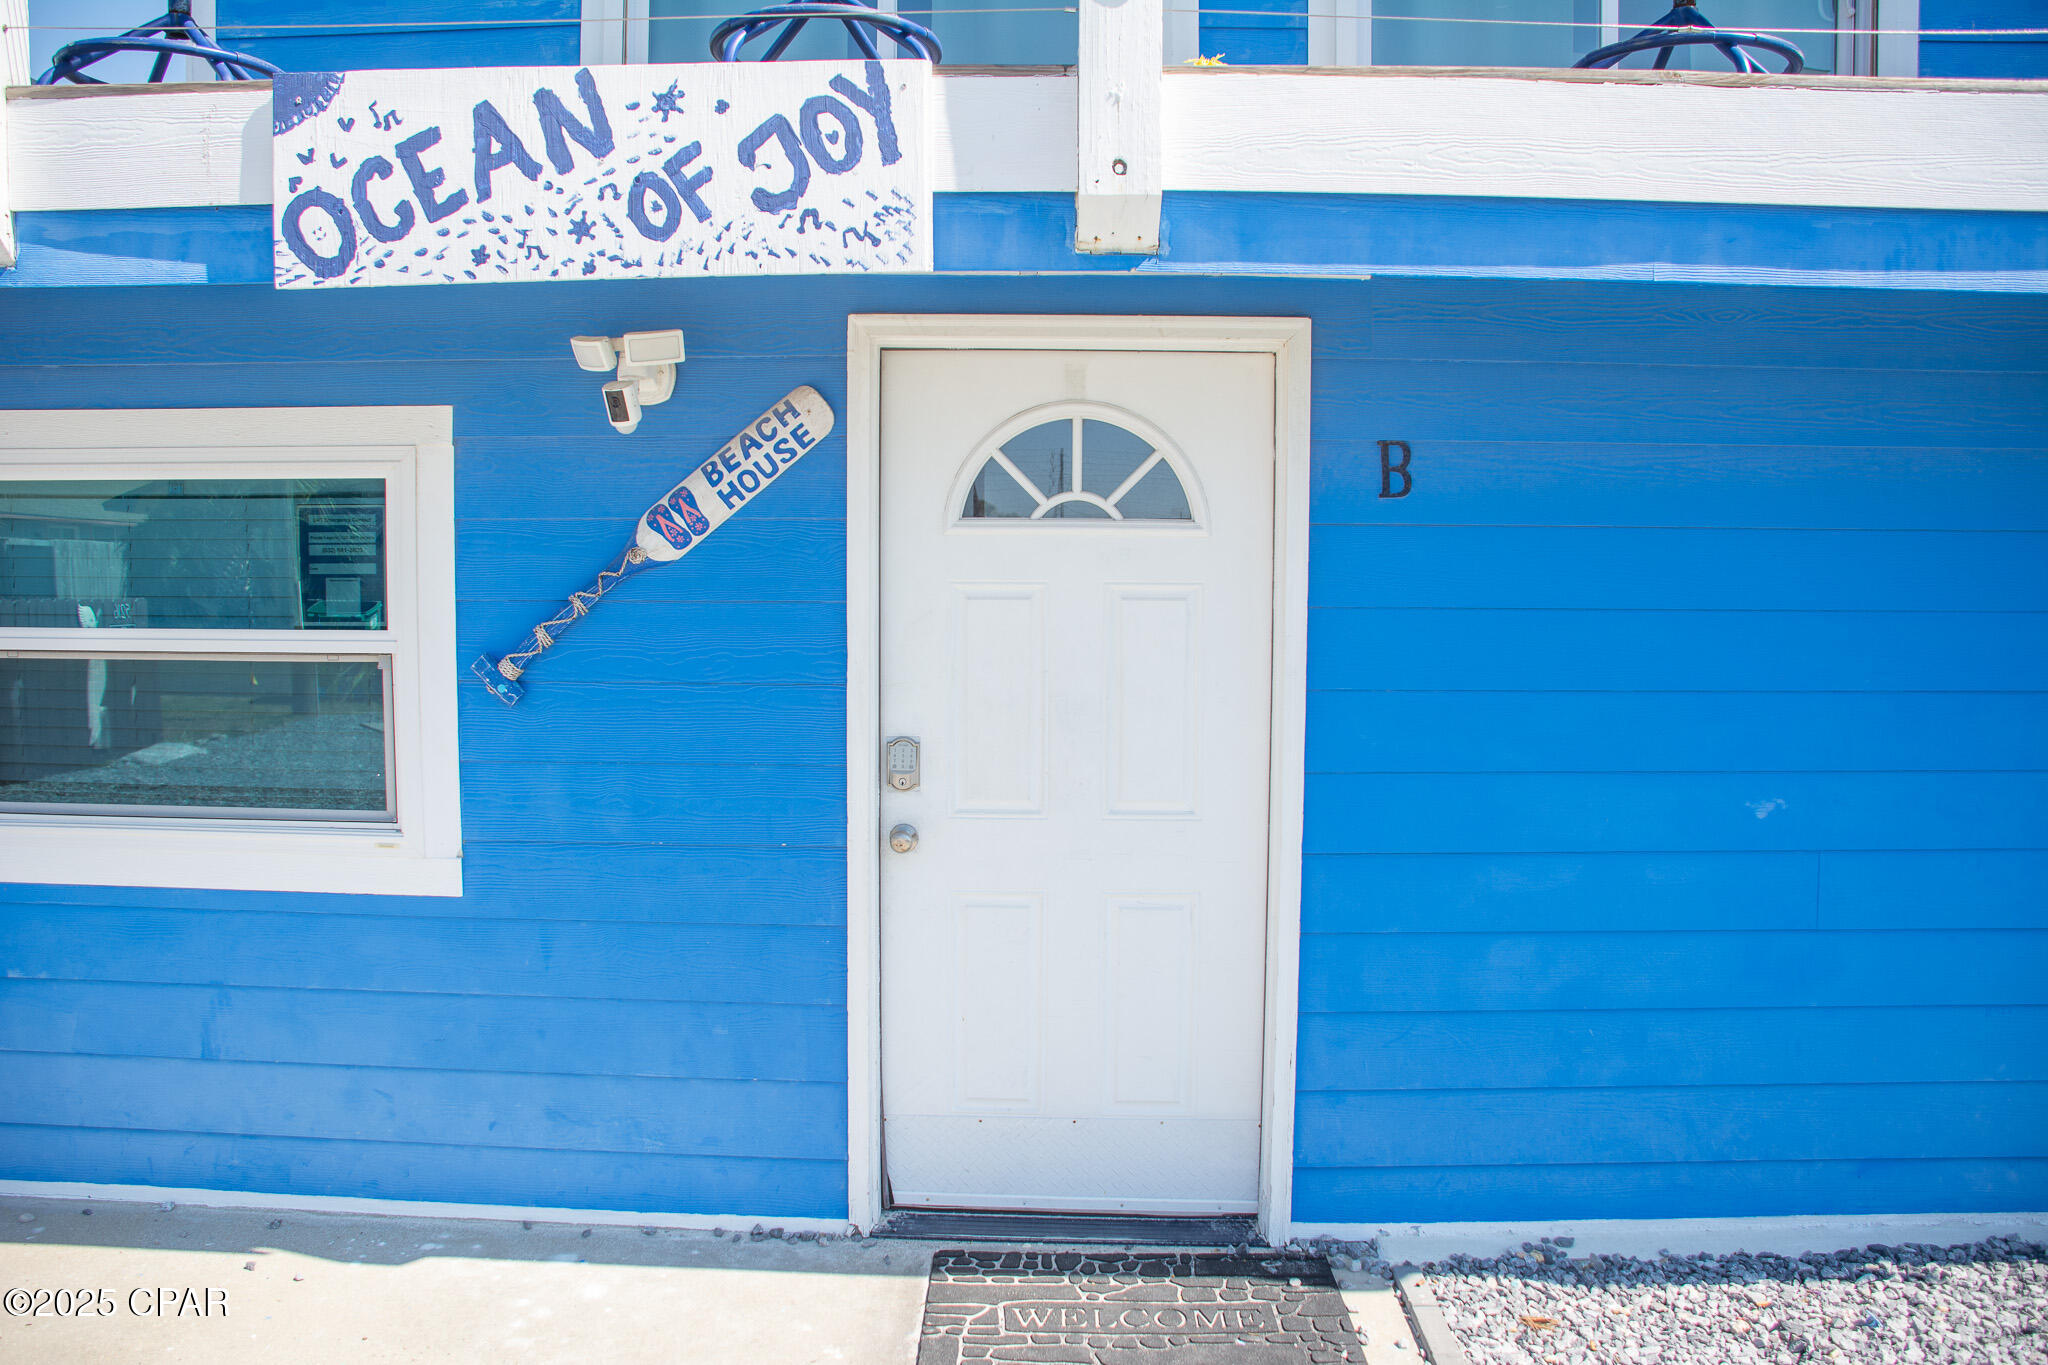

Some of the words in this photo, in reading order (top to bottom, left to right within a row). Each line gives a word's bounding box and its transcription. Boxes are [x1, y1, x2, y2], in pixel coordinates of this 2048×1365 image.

[281, 66, 615, 279] OCEAN
[627, 139, 714, 243] OF
[738, 60, 903, 215] JOY
[700, 398, 801, 488] BEACH
[716, 422, 817, 511] HOUSE
[1376, 439, 1413, 499] B
[1011, 1306, 1267, 1331] WELCOME
